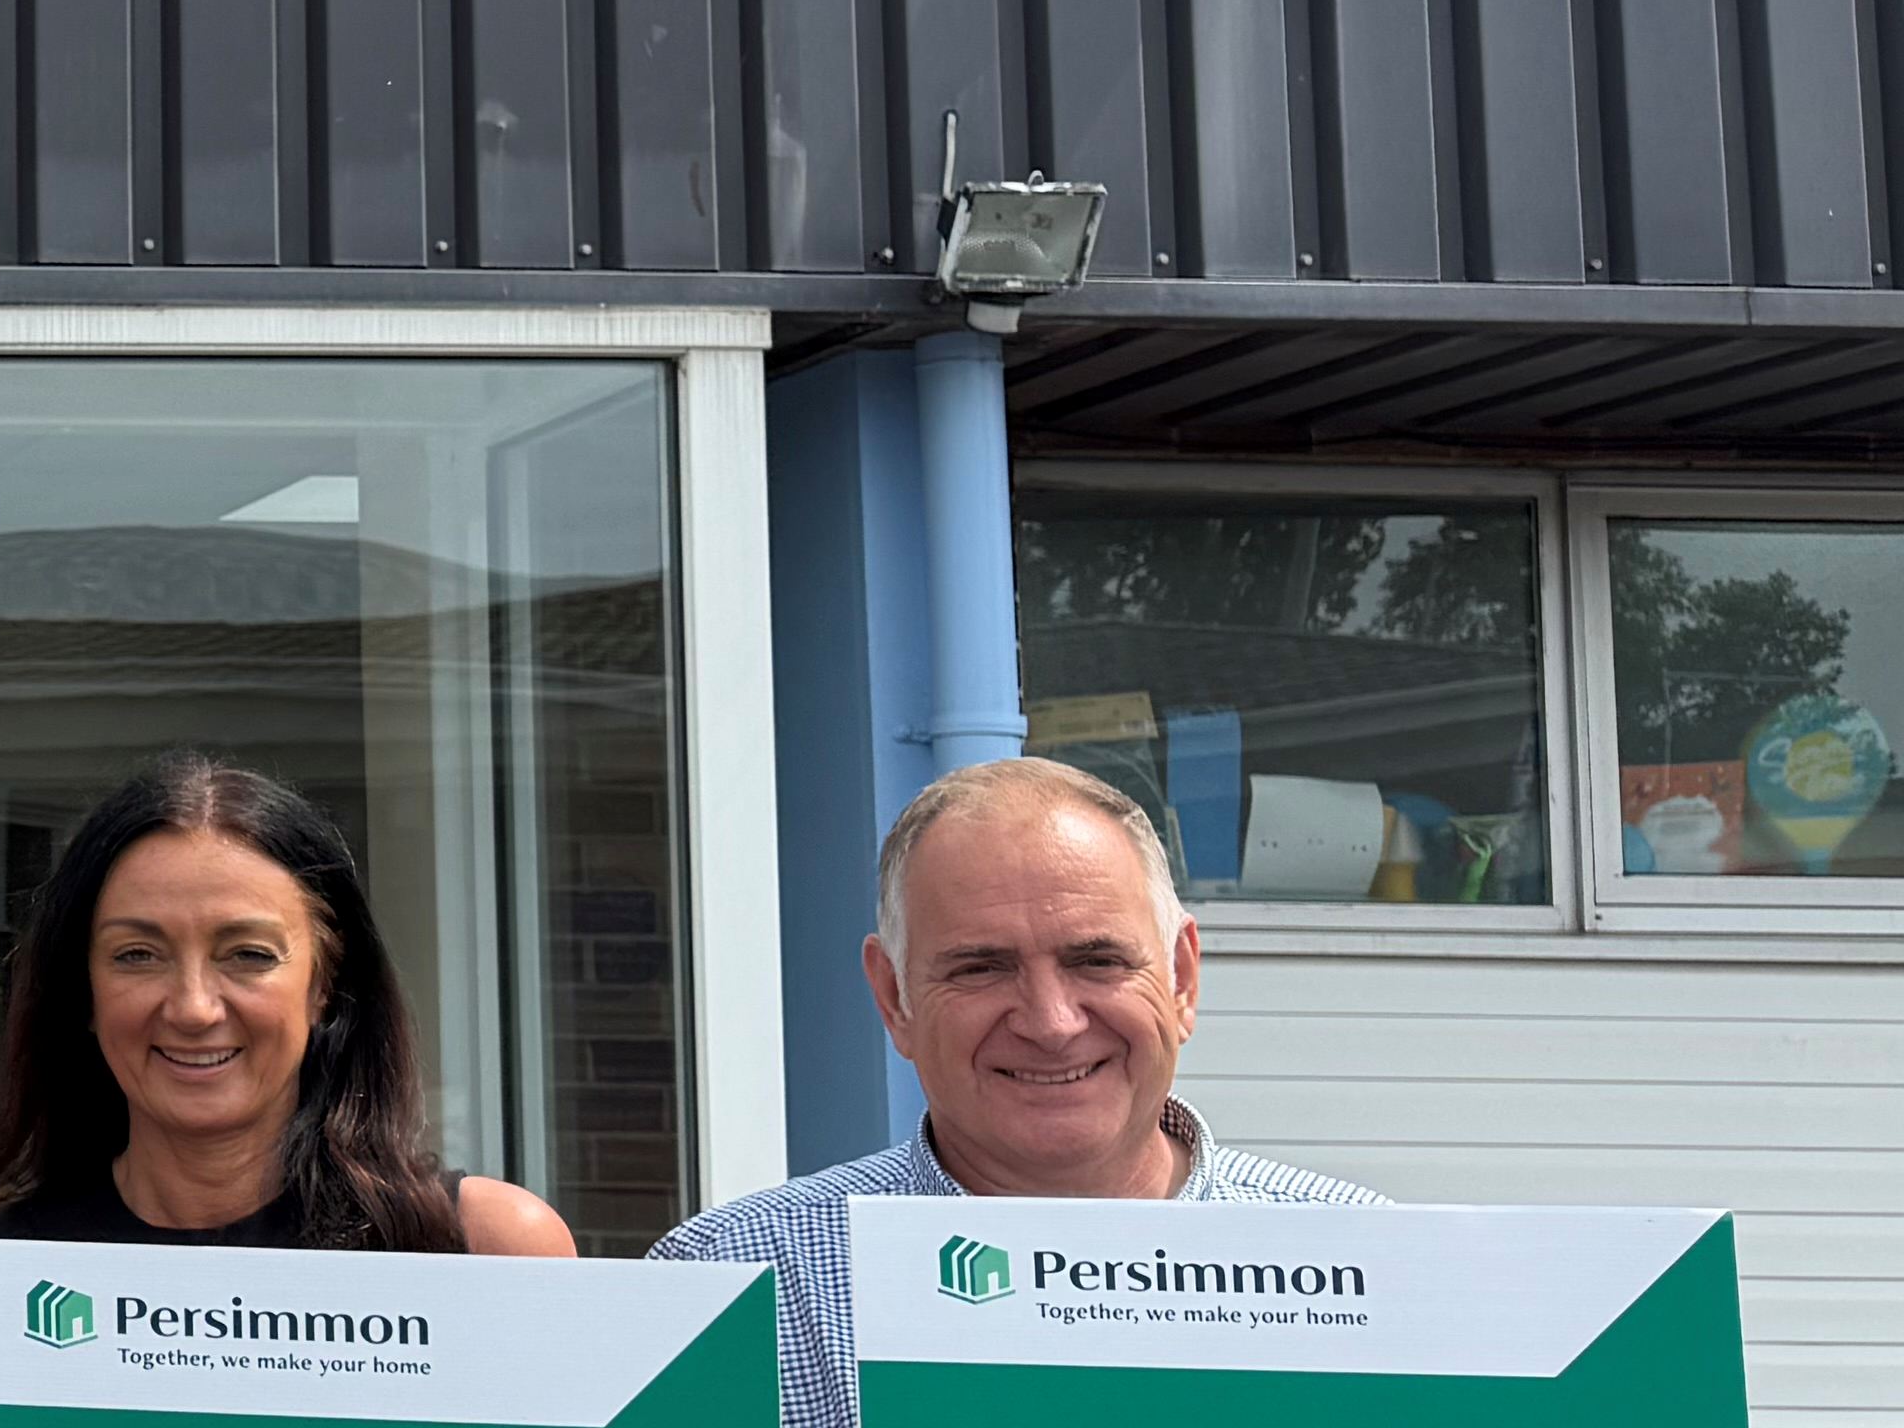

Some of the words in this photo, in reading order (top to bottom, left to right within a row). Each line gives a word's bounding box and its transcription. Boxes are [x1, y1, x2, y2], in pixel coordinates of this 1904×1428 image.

[1034, 1249, 1365, 1296] Persimmon
[117, 1297, 429, 1346] Persimmon
[1036, 1303, 1140, 1325] Together,
[1146, 1309, 1176, 1322] we
[1183, 1305, 1242, 1323] make
[1249, 1311, 1300, 1329] your
[1306, 1307, 1368, 1326] home
[117, 1348, 215, 1371] Together,
[221, 1355, 250, 1369] we
[257, 1353, 312, 1371] make
[319, 1359, 367, 1377] your
[373, 1355, 431, 1375] home
